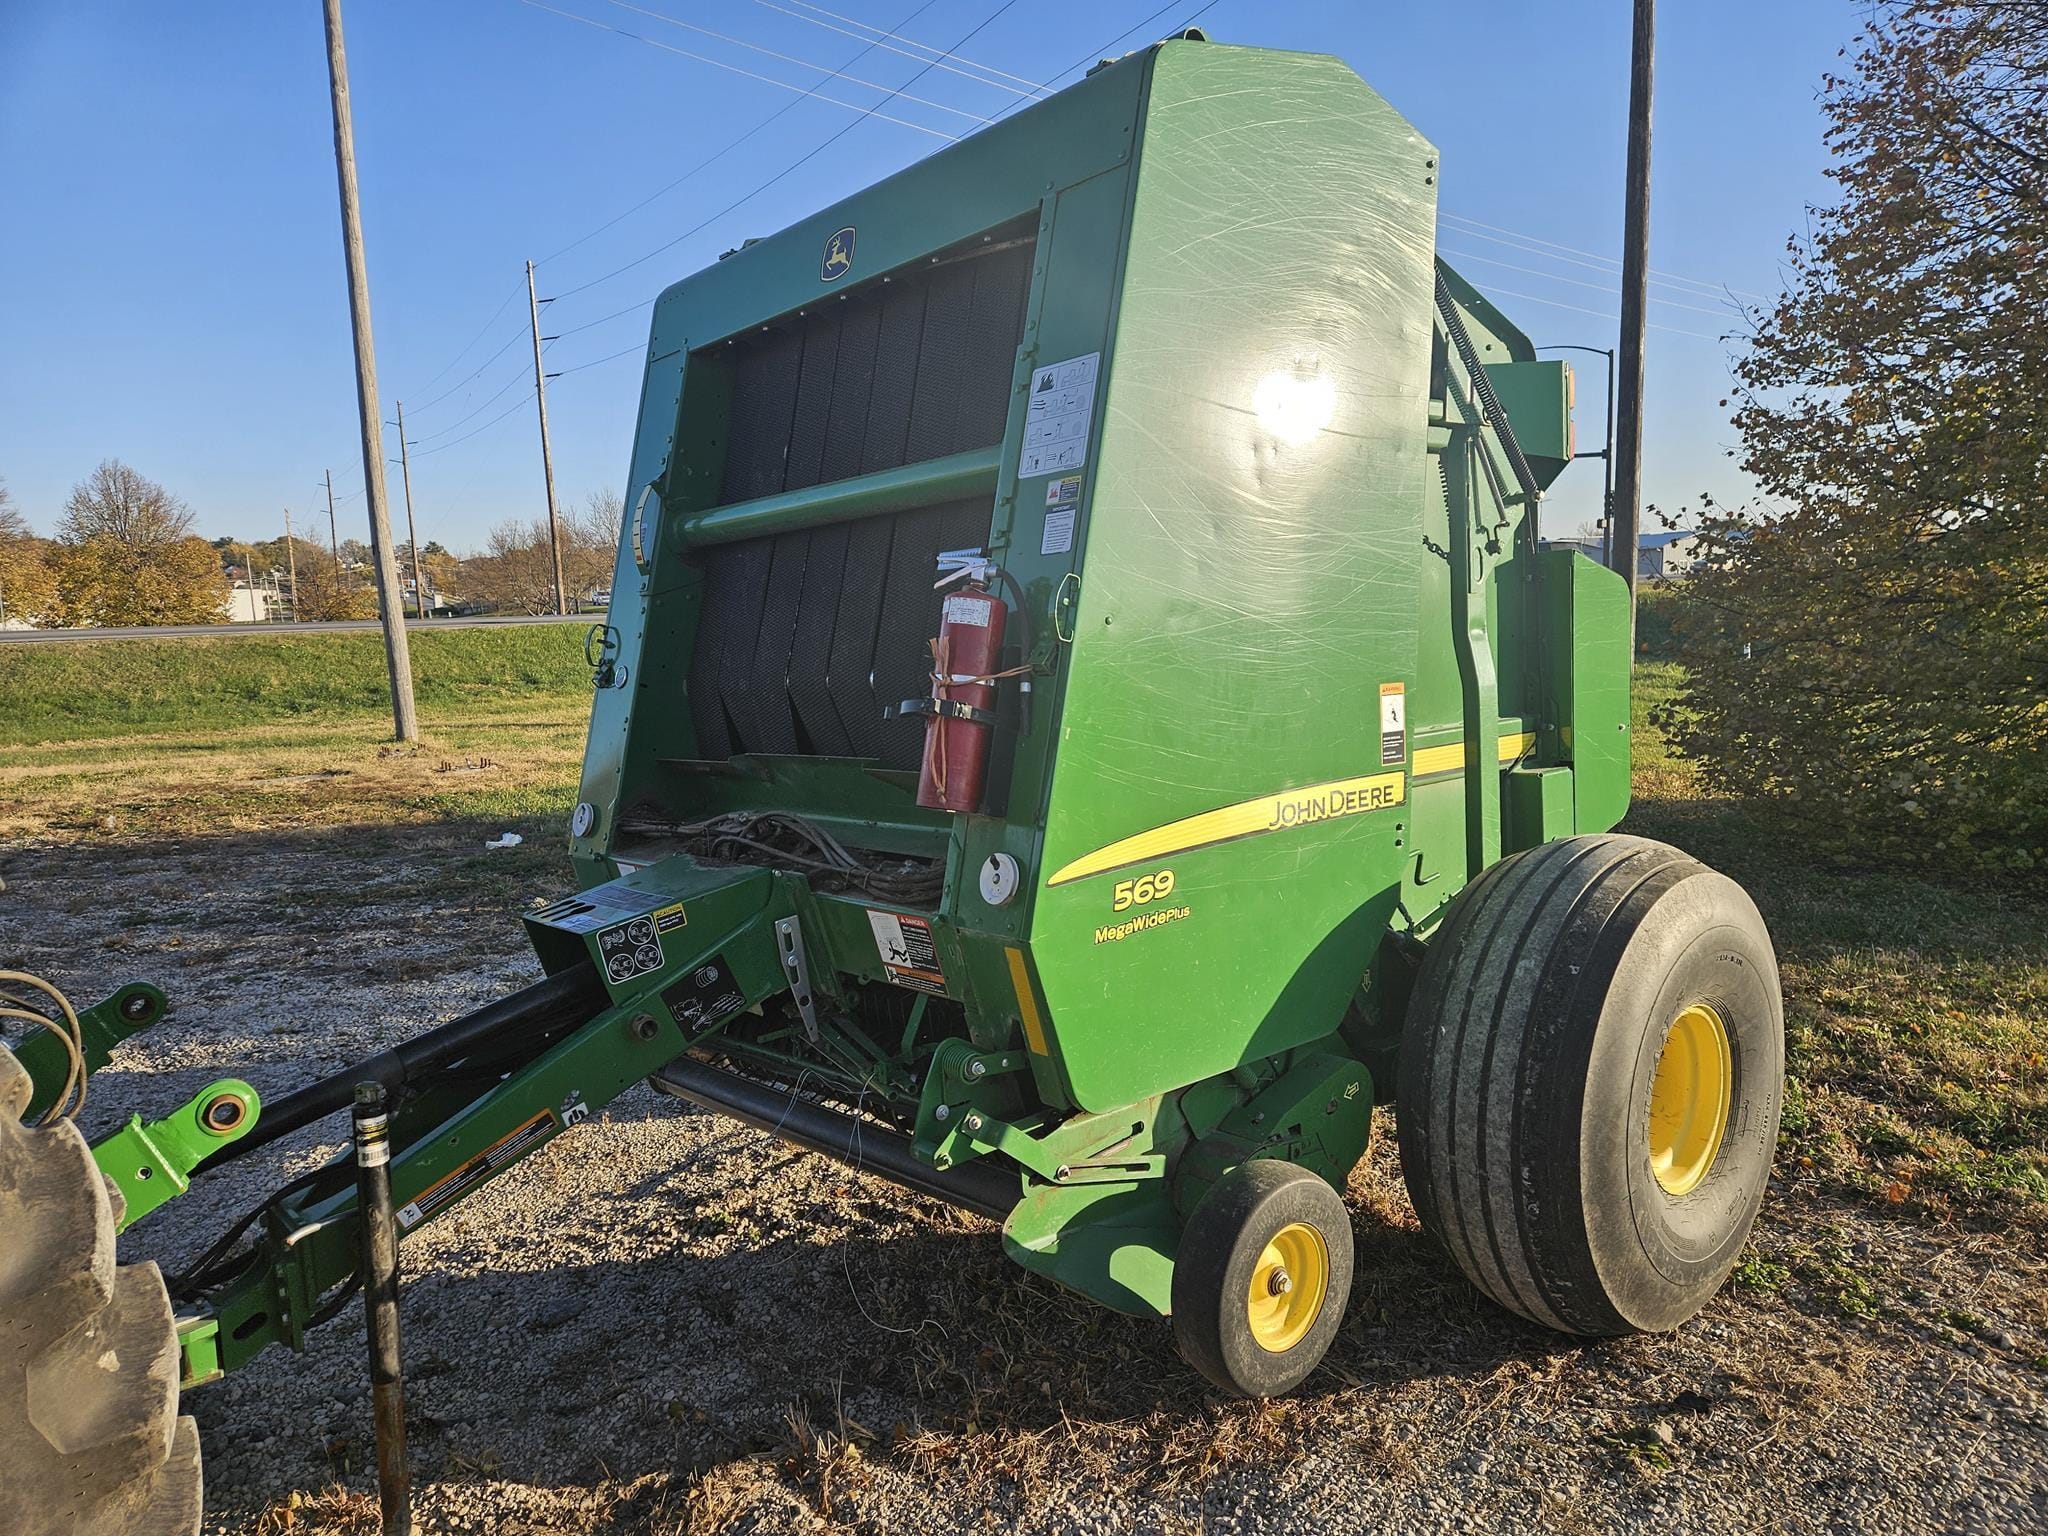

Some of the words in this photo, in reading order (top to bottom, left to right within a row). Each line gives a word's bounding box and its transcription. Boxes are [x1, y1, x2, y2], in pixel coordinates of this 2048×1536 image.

[1269, 796, 1326, 827] JOHN
[1330, 784, 1394, 815] DEERE
[1113, 869, 1176, 912] 569
[1094, 906, 1191, 945] MegaWidePlus
